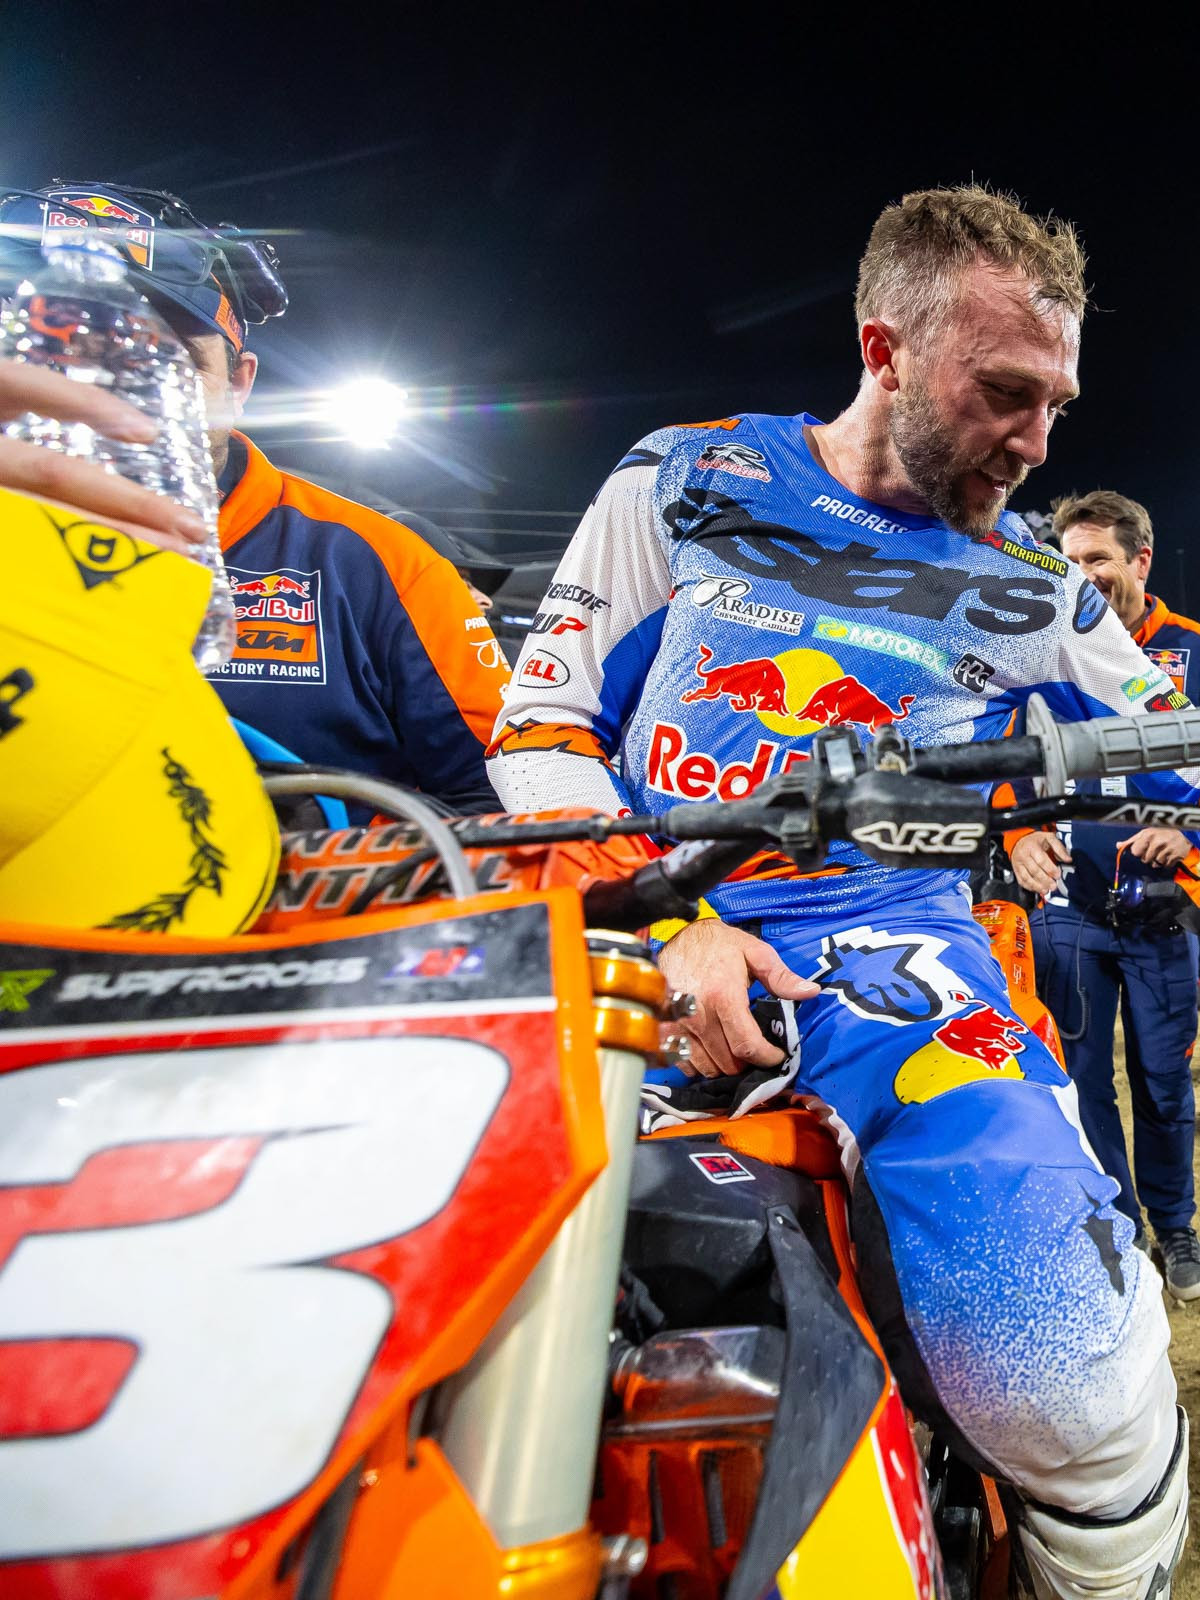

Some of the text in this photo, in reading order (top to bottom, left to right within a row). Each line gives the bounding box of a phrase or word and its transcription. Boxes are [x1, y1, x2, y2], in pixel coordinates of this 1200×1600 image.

[1003, 540, 1067, 575] AKRAPOVIC
[234, 598, 315, 622] ed Bull
[691, 572, 803, 627] PARADISE
[713, 610, 799, 635] CHEVROLET CADILLAC
[848, 626, 949, 671] MOTOREX
[212, 662, 320, 678] ACTORY RACING
[523, 659, 557, 682] ELL
[851, 820, 986, 854] ARC
[57, 957, 370, 1002] SUPERCROSS
[0, 1034, 512, 1562] 3
